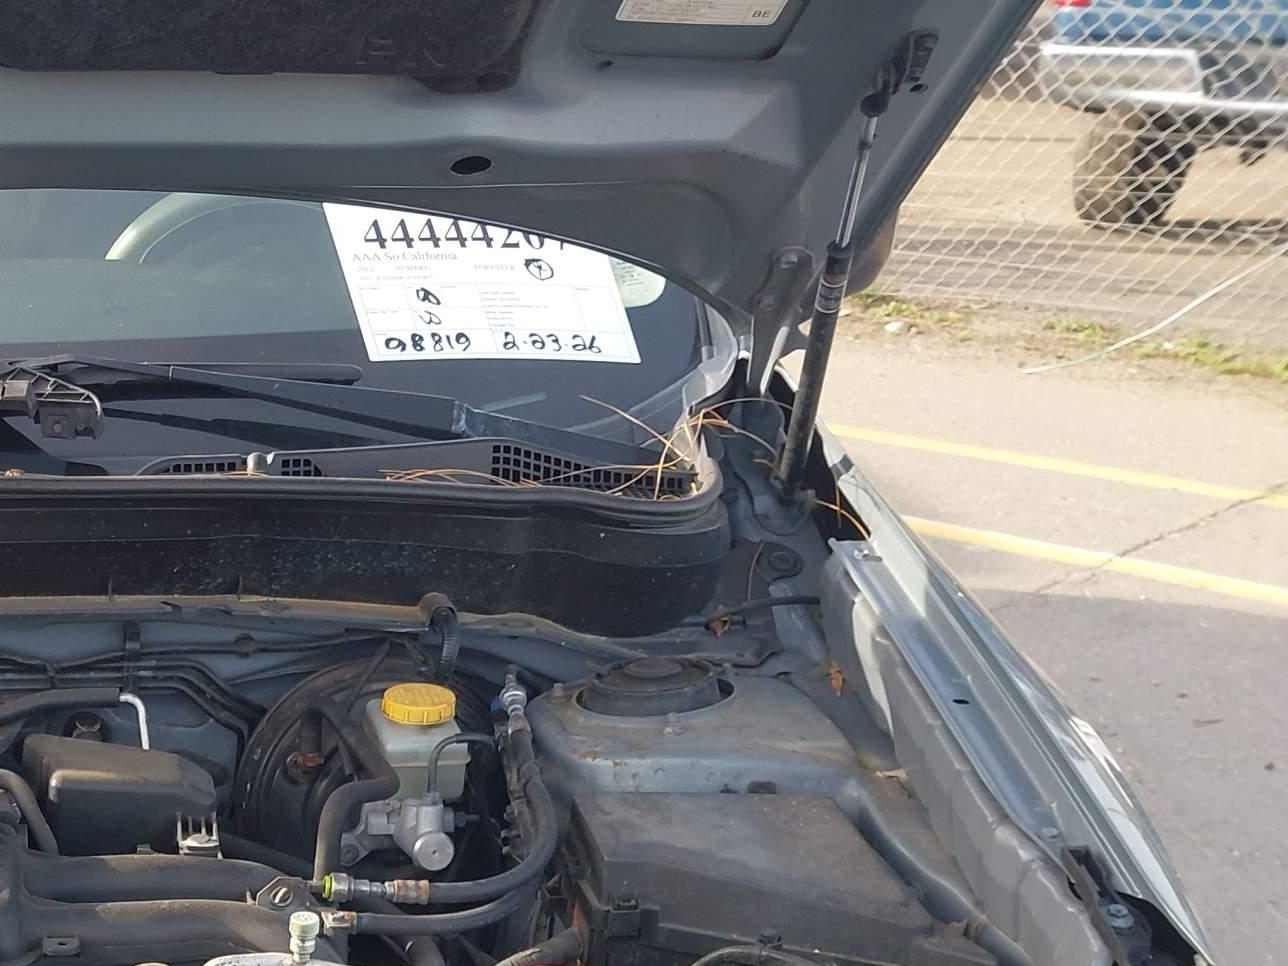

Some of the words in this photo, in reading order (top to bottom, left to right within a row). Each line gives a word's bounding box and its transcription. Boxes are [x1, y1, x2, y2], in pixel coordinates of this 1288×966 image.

[751, 10, 772, 18] BE
[352, 253, 381, 262] AAA
[384, 251, 400, 261] So
[403, 250, 458, 261] California
